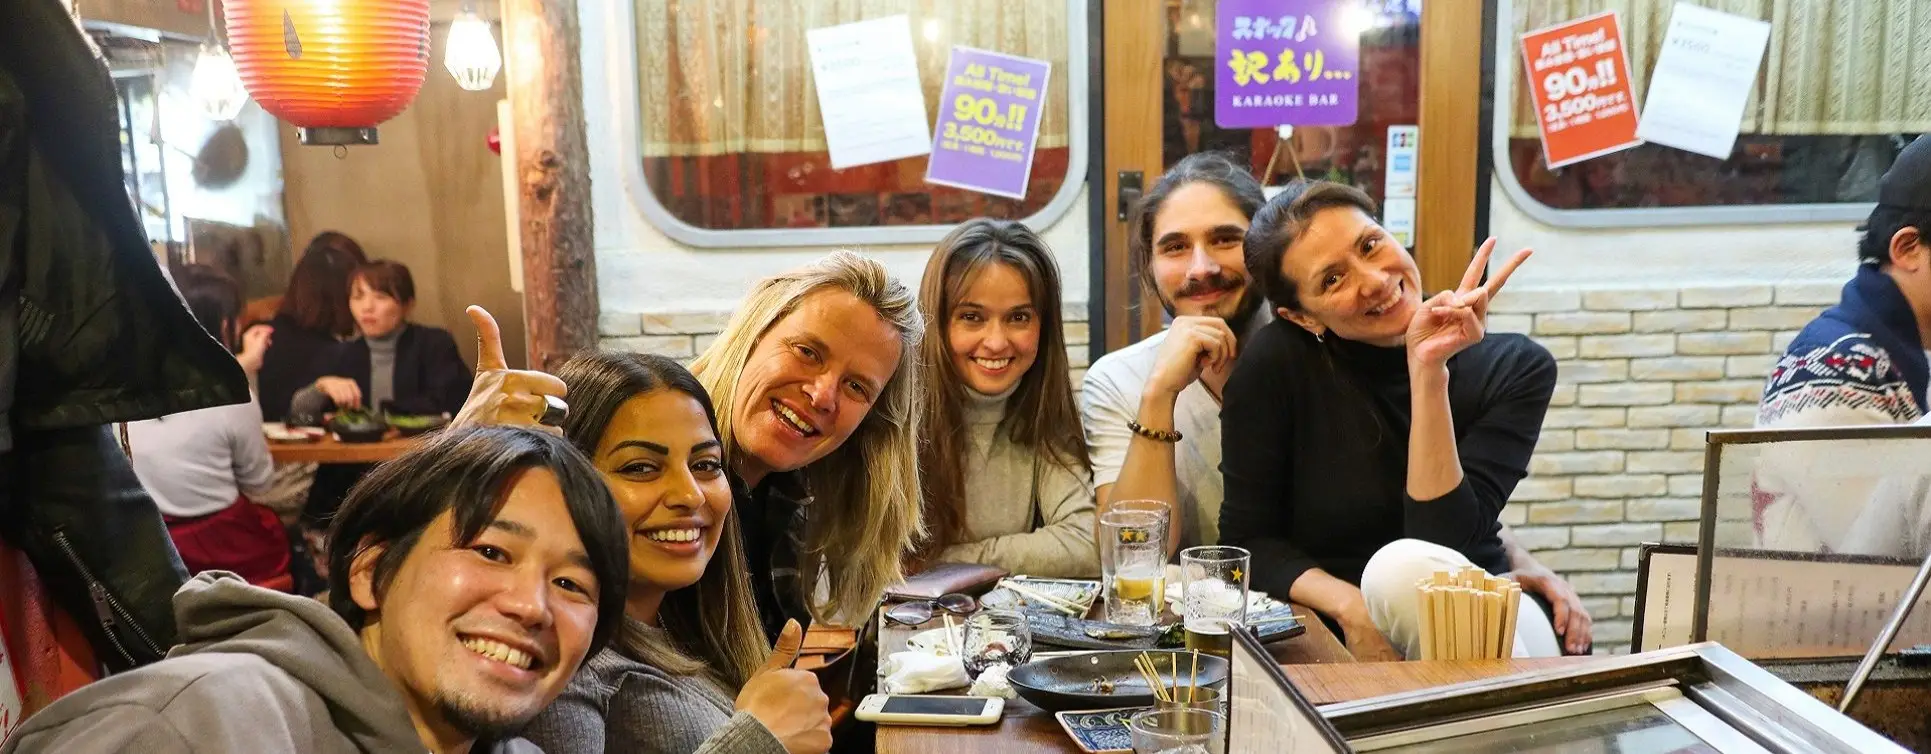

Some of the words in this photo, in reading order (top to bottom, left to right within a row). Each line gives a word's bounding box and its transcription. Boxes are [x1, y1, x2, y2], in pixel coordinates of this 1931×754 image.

[1541, 39, 1562, 58] All
[963, 63, 986, 78] All
[1232, 94, 1304, 108] KARAOKE
[1308, 93, 1339, 107] BAR
